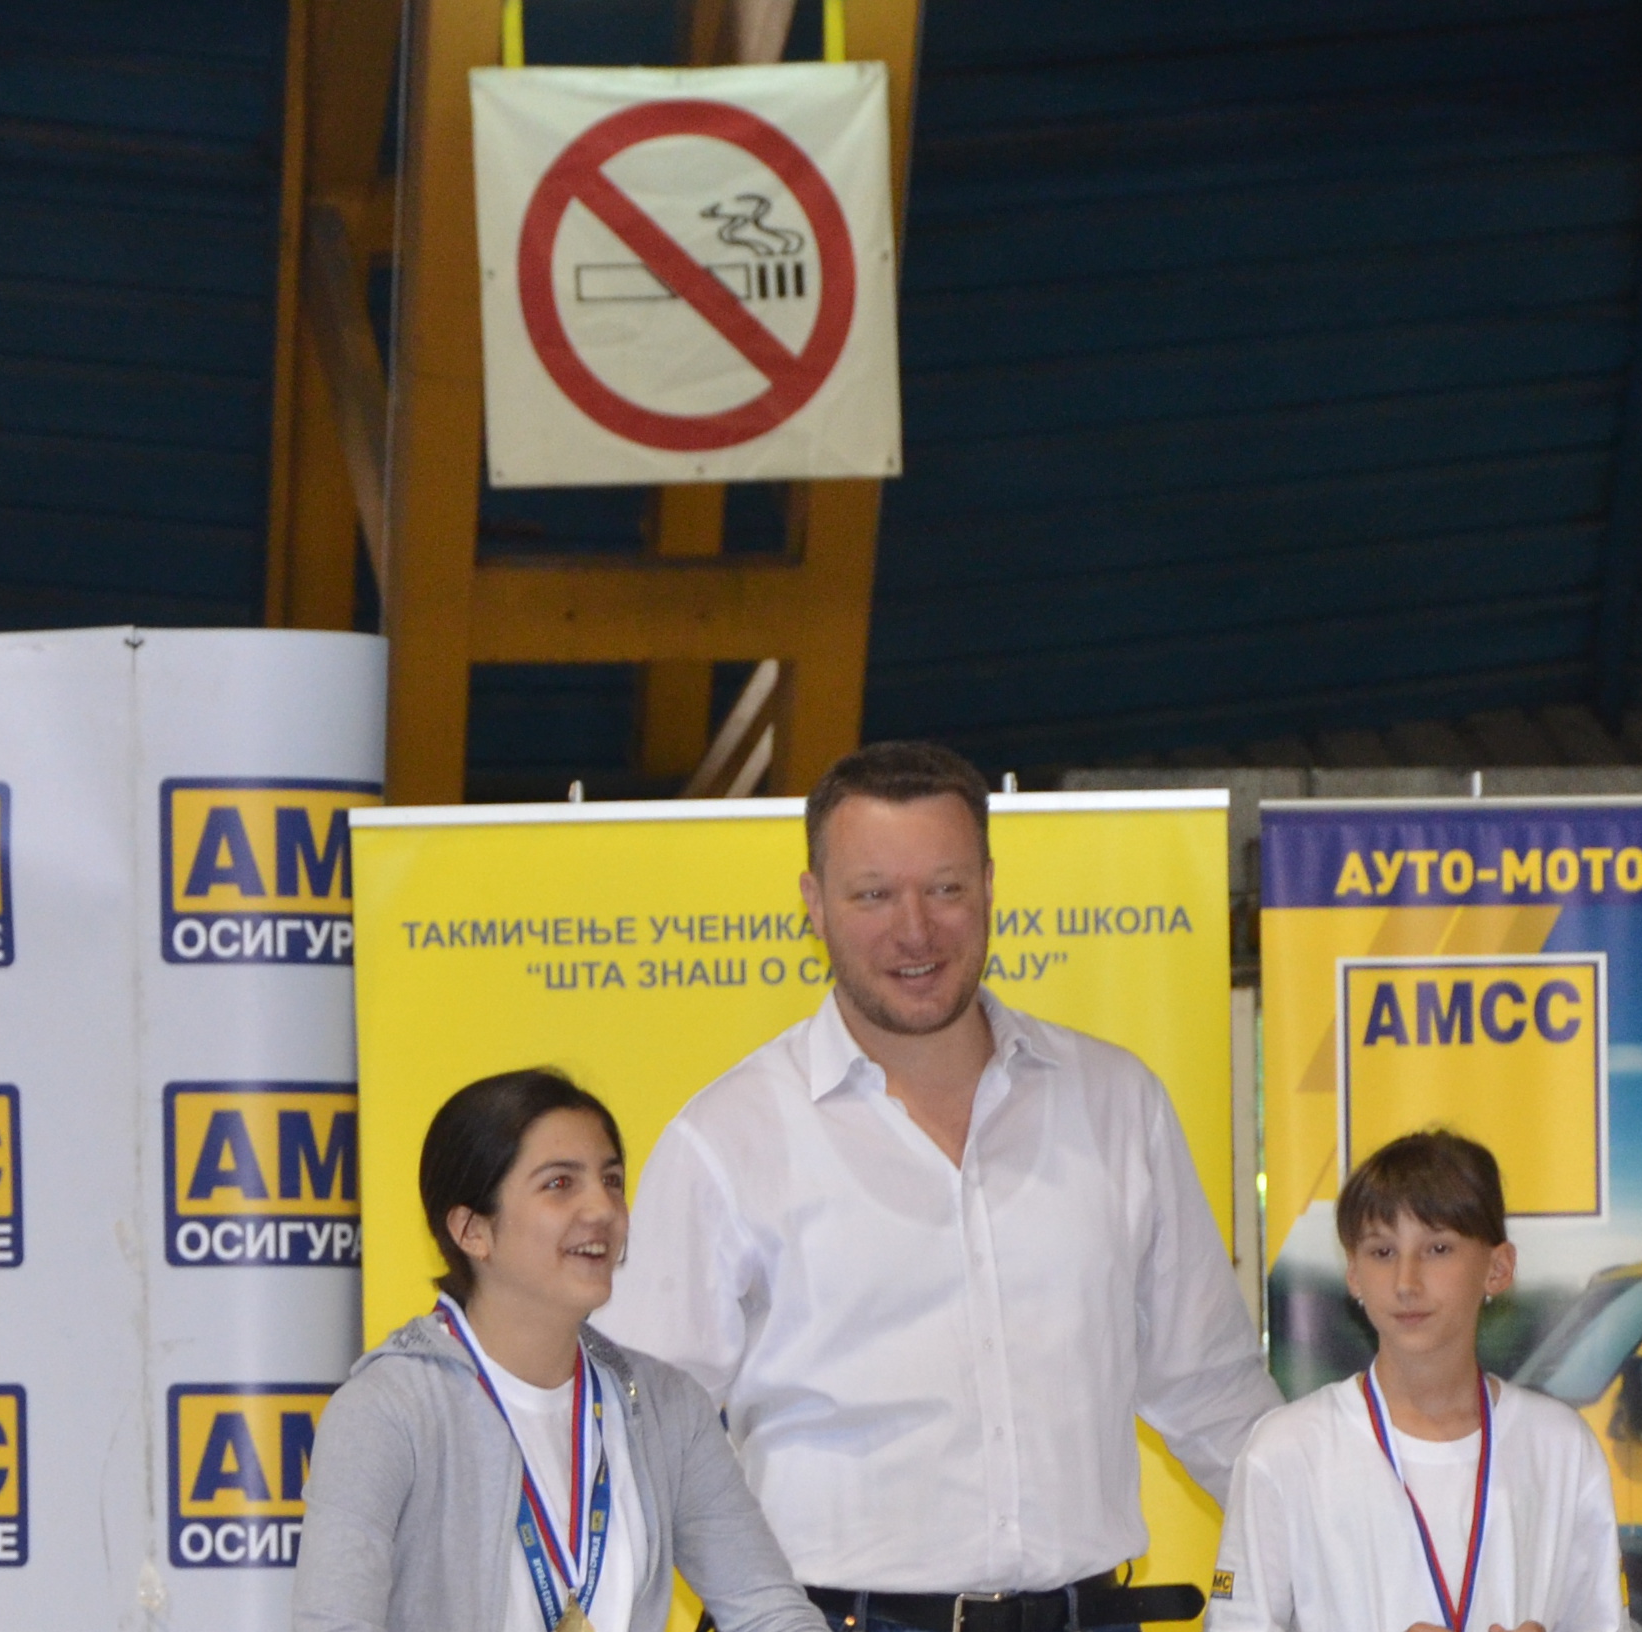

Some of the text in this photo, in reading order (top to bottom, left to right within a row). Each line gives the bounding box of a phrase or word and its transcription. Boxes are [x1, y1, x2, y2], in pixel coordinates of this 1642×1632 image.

[183, 804, 353, 898] АМ
[173, 918, 354, 957] ОСИГУР
[402, 916, 635, 950] ТАКМИЧЕЊЕ
[650, 911, 823, 945] УЧЕНИКА
[1058, 905, 1193, 938] ШКОЛА
[638, 955, 750, 988] ЗНАШ
[757, 954, 788, 986] О
[1362, 979, 1582, 1047] АМСС
[187, 1109, 356, 1200] АМ
[176, 1221, 361, 1261] ОСИГУР
